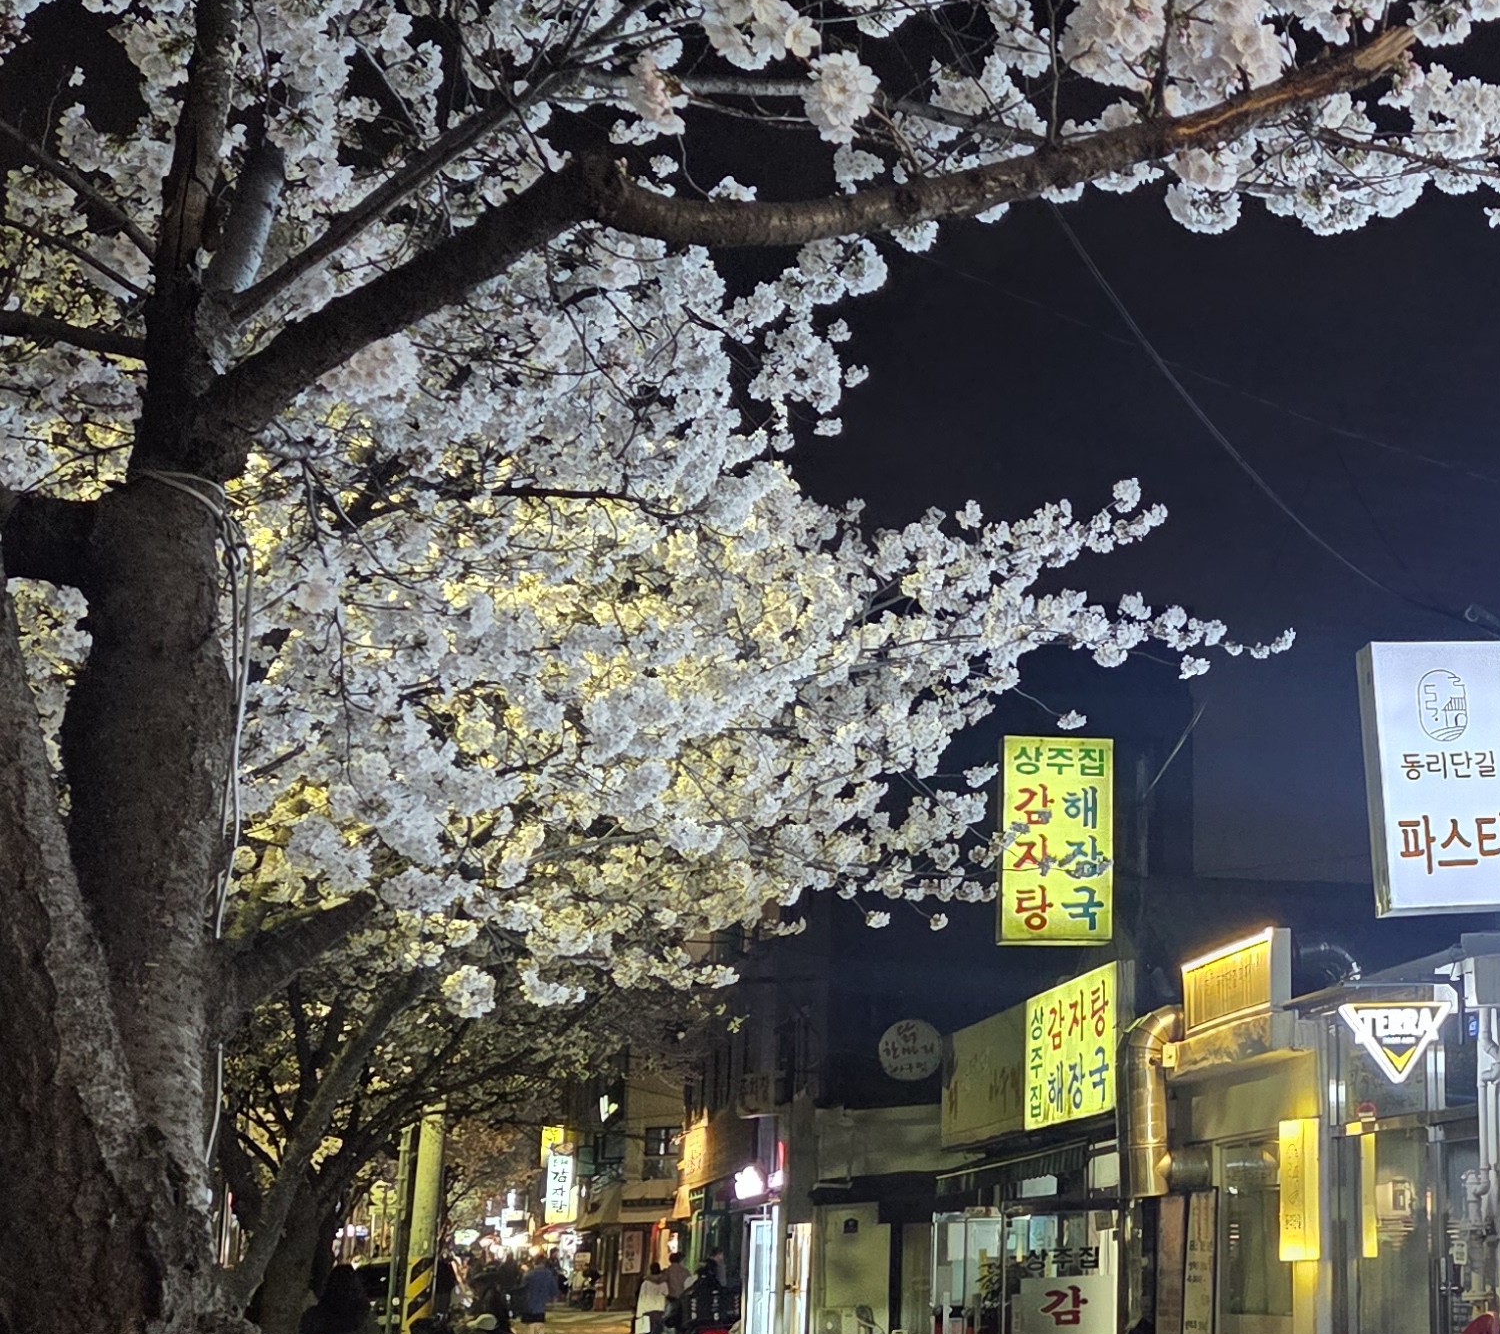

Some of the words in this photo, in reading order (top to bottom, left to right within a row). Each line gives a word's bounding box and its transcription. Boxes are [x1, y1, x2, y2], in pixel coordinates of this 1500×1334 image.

[1013, 746, 1105, 777] 상주집
[1400, 750, 1497, 781] 동리단길
[1013, 783, 1055, 931] 감자탕
[1058, 785, 1105, 931] 해장국
[1047, 979, 1109, 1052] 감자탕
[1030, 1005, 1045, 1119] 상주집
[1047, 1045, 1109, 1114] 해장국
[1025, 1246, 1100, 1271] 상주집
